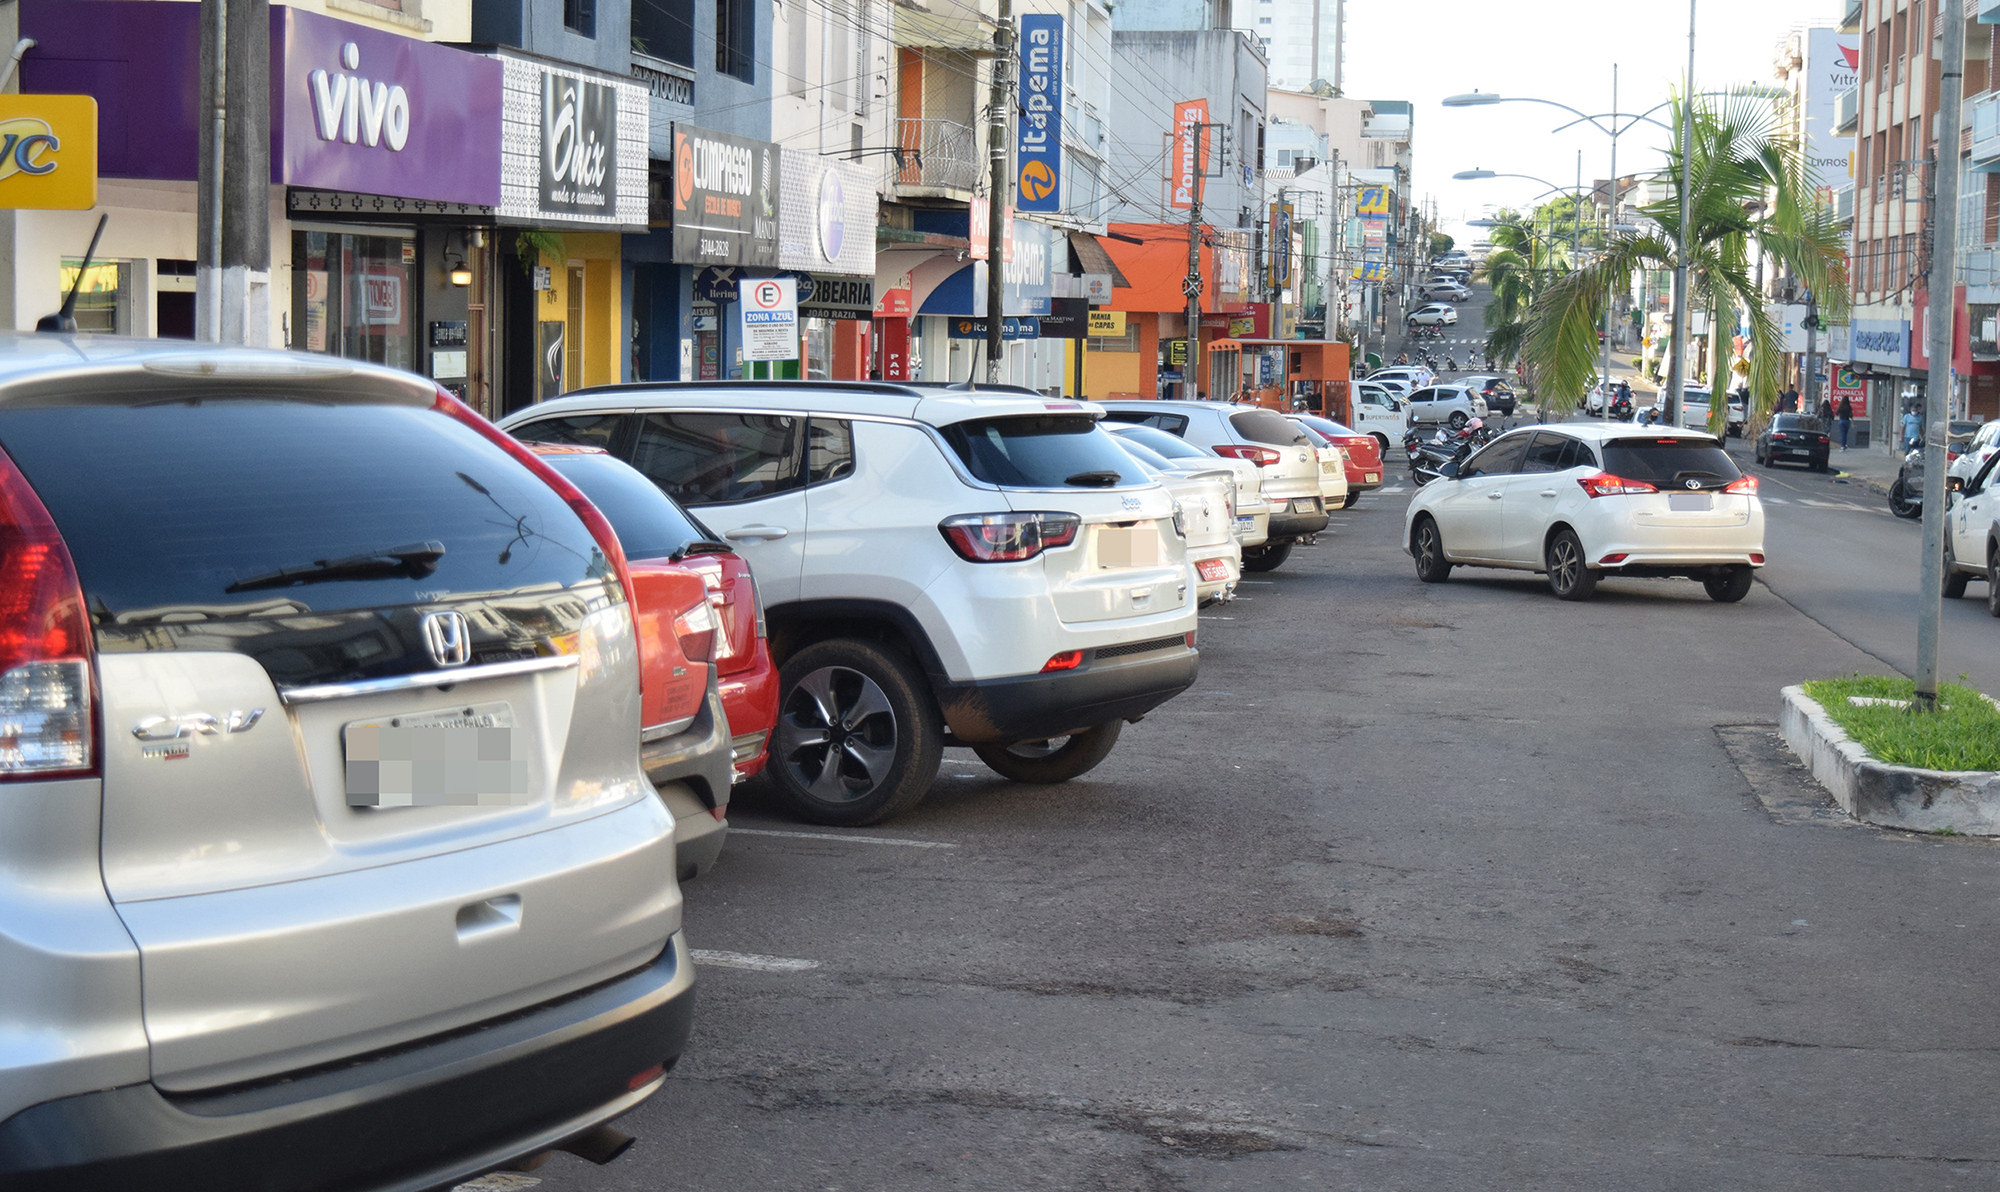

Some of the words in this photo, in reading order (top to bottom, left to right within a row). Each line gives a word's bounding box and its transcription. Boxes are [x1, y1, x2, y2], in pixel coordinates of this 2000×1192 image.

[311, 42, 410, 152] vivo
[1020, 29, 1052, 153] itapema
[552, 86, 606, 188] Ônix
[692, 137, 753, 196] COMPASSO
[1810, 157, 1848, 168] LIVROS
[551, 185, 570, 203] moda
[571, 192, 576, 204] e
[754, 215, 777, 240] MANDY
[709, 289, 738, 300] Hering
[762, 287, 774, 303] E
[746, 313, 770, 322] ZONA
[771, 311, 793, 321] AZUL
[806, 309, 830, 318] JOÃO
[831, 311, 857, 320] RAZIA
[1090, 313, 1111, 321] MANIA
[1094, 321, 1116, 329] CAPAS
[1833, 395, 1864, 403] POLAR
